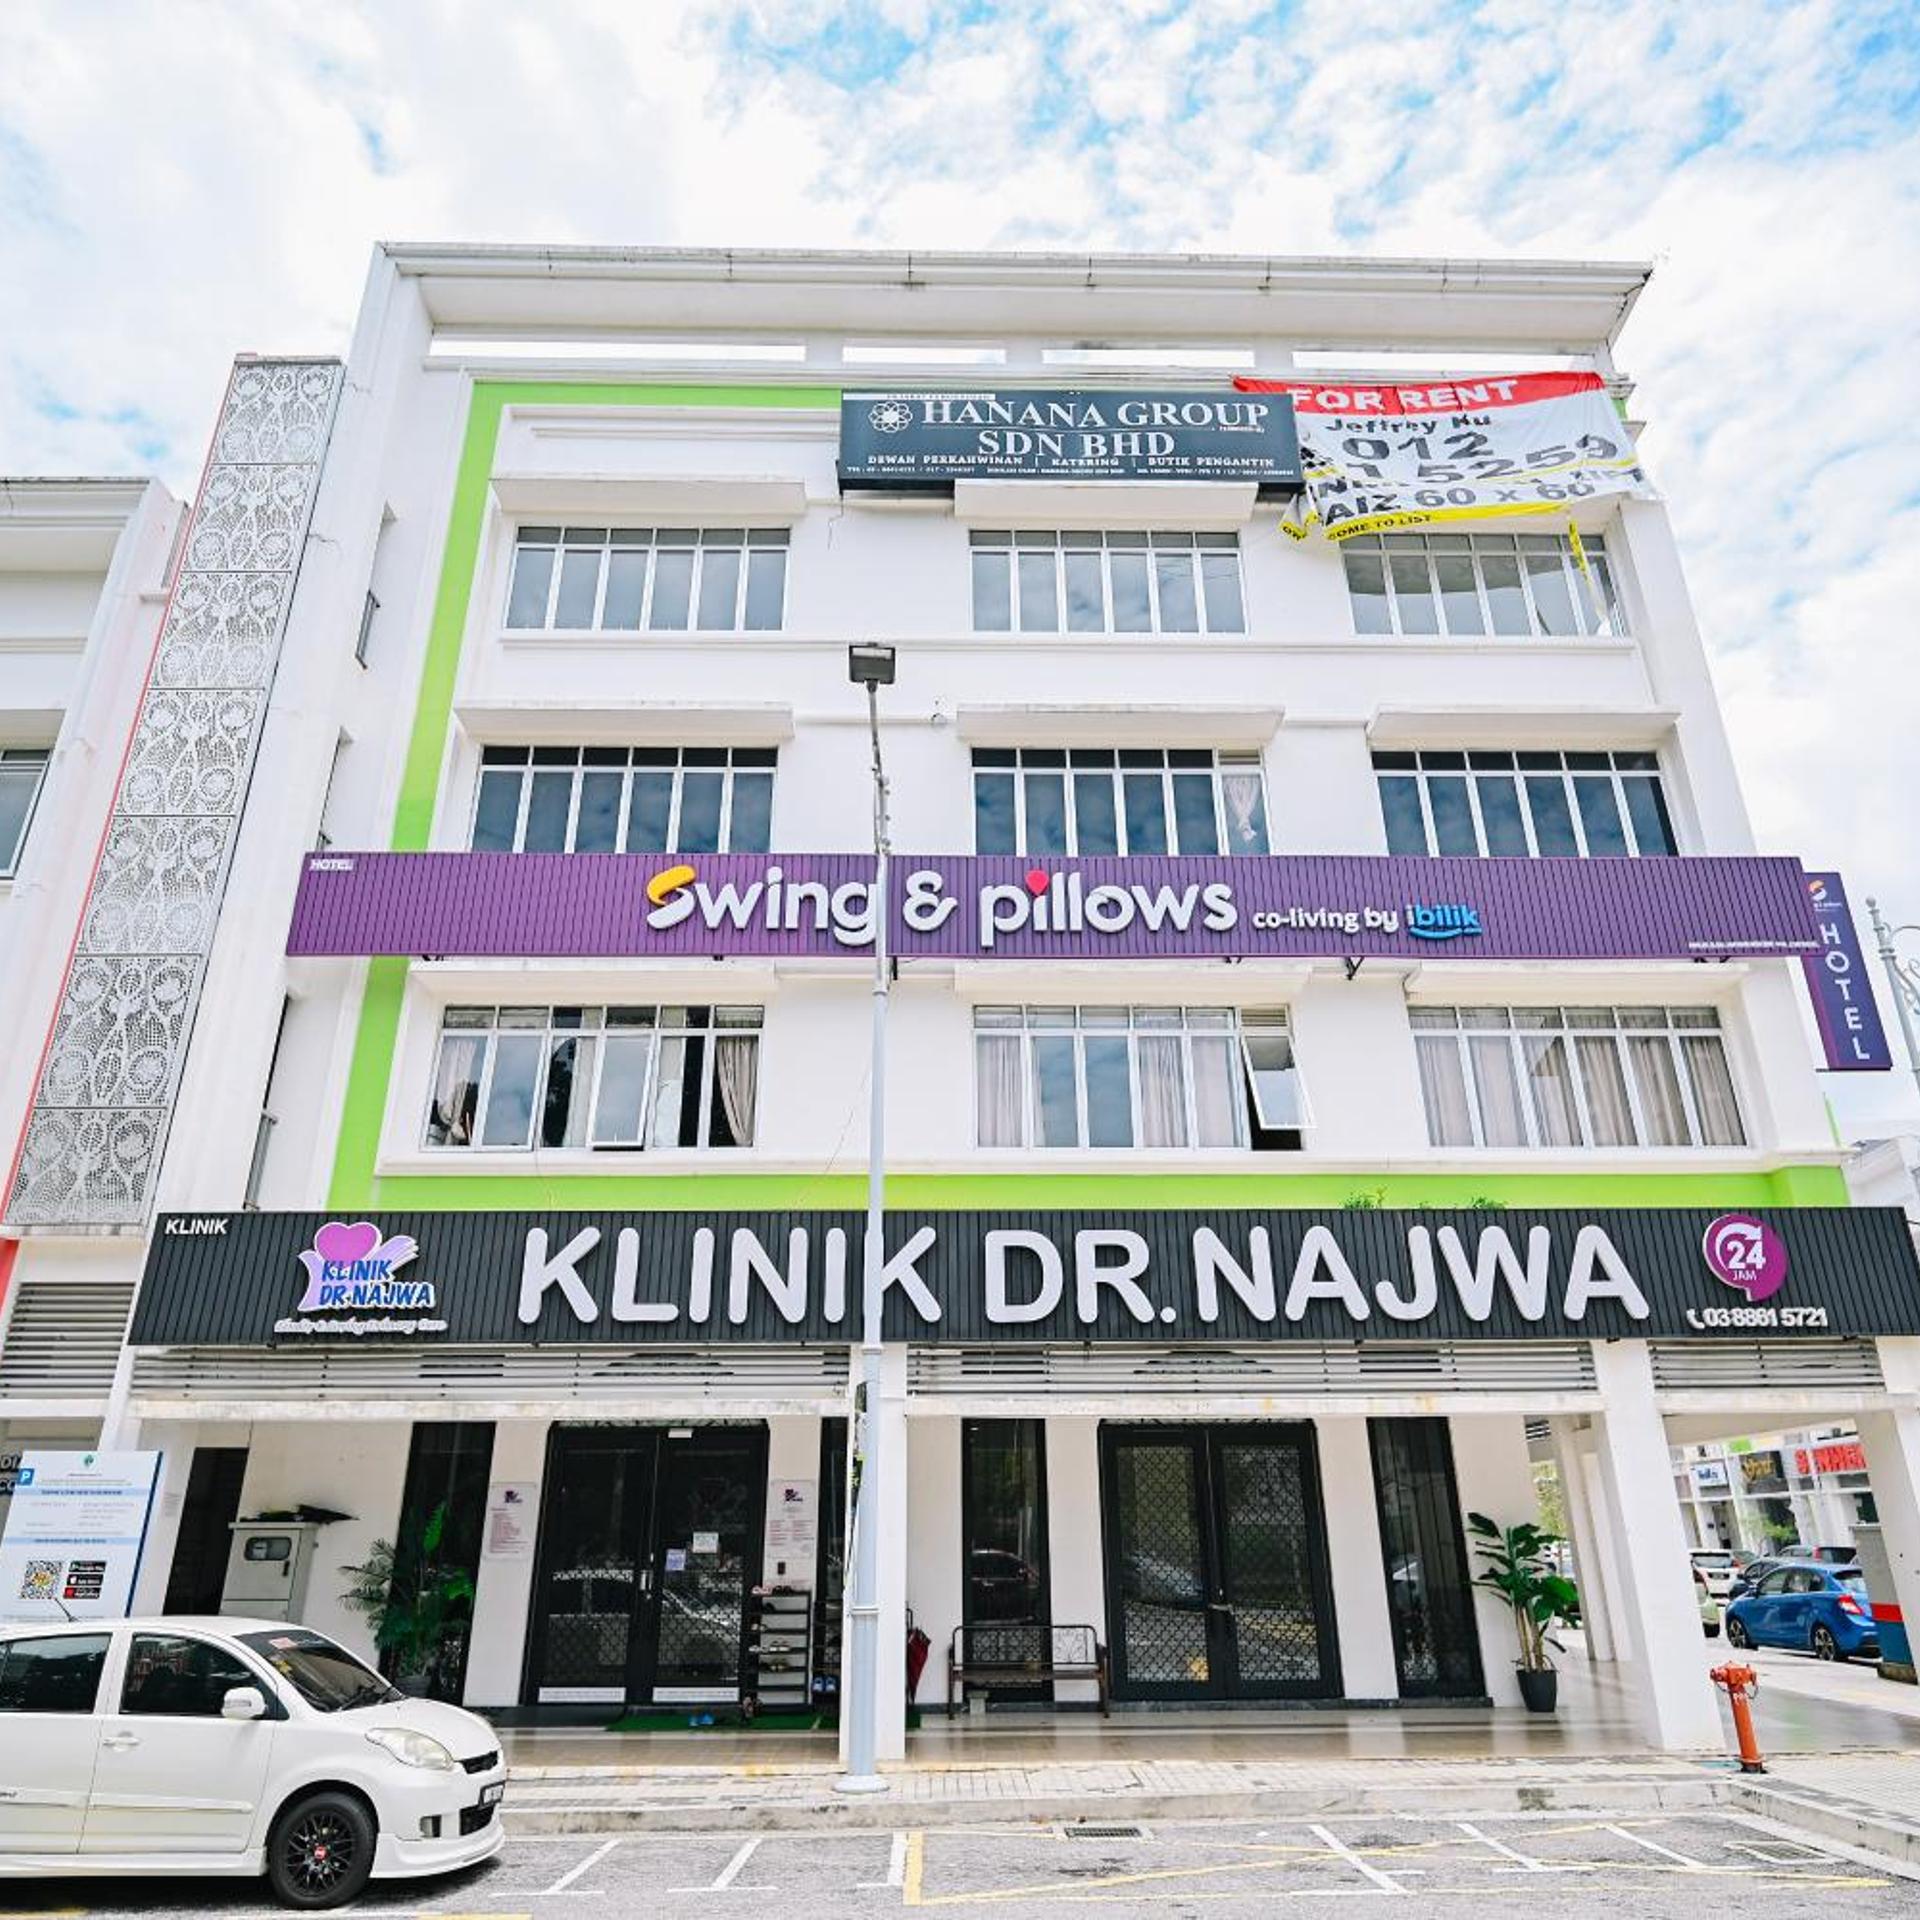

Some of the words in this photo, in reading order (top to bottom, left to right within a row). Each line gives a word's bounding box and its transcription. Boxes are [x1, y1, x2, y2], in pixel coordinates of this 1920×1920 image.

[1286, 388, 1386, 411] FOR
[1398, 379, 1519, 408] RENT
[922, 400, 1108, 428] HANANA
[1117, 401, 1269, 427] GROUP
[978, 430, 1065, 457] SDN
[1079, 431, 1176, 458] BHD
[1342, 431, 1494, 461] 012
[867, 454, 916, 465] DEWAN
[1148, 456, 1191, 466] BUTIK
[1196, 456, 1275, 468] PENGANTIN
[1414, 487, 1477, 507] 60
[309, 858, 354, 871] HOTEL
[646, 864, 878, 946] Swing
[902, 869, 958, 931] &
[980, 869, 1239, 946] pillows
[1253, 907, 1360, 933] co-living
[1364, 906, 1399, 933] by
[1405, 904, 1480, 927] ibilik
[1819, 922, 1870, 1060] HOTEL
[164, 1218, 229, 1235] KLINIK
[1727, 1240, 1767, 1270] 24
[321, 1259, 394, 1282] KLINIK
[518, 1226, 942, 1324] KLINIK
[1733, 1269, 1758, 1281] JAM
[1780, 1307, 1828, 1327] 5721
